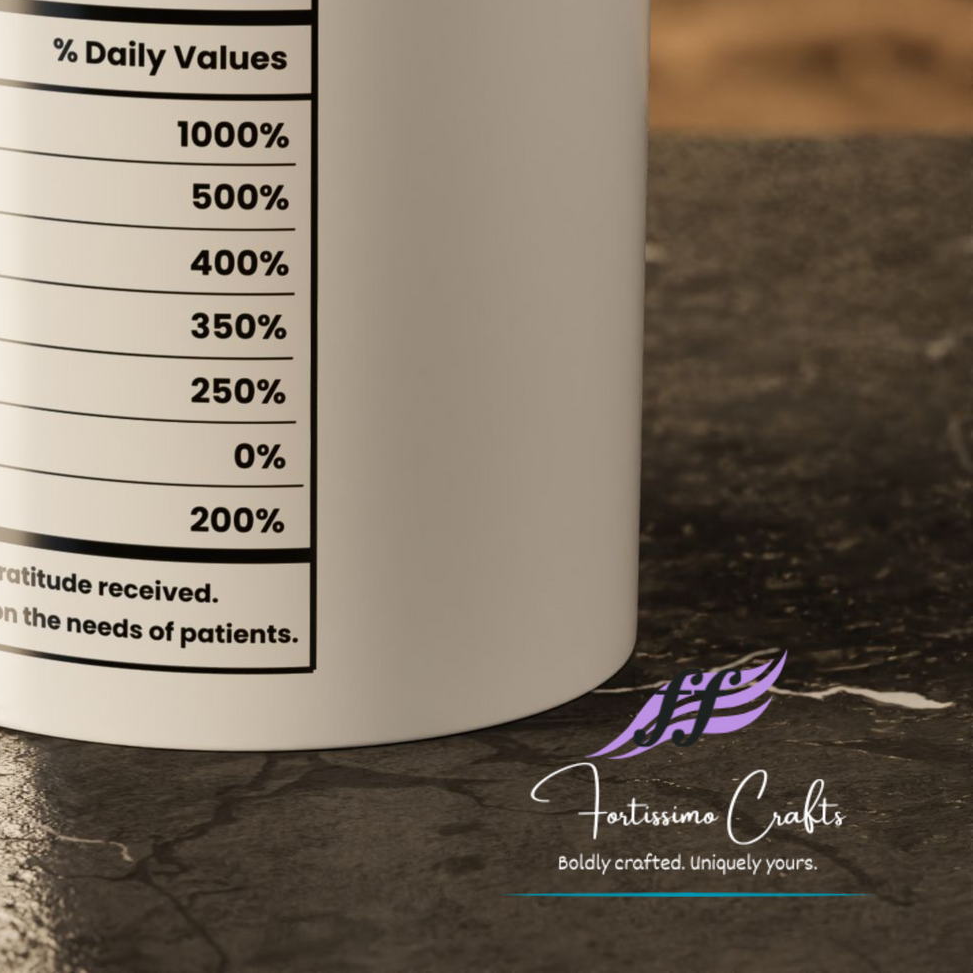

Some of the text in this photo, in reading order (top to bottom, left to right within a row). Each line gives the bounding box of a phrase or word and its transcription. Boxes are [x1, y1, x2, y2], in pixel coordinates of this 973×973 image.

[53, 37, 288, 76] % Daily Values
[177, 120, 290, 149] 1000%
[192, 183, 290, 210] 500%
[190, 249, 289, 276] 400%
[190, 312, 287, 340] 350%
[190, 377, 286, 404] 250%
[234, 443, 286, 469] 0%
[190, 506, 285, 533] 200%
[98, 580, 219, 604] received.
[23, 607, 62, 630] the
[67, 615, 143, 640] needs
[149, 621, 175, 641] of
[180, 623, 300, 649] patients.
